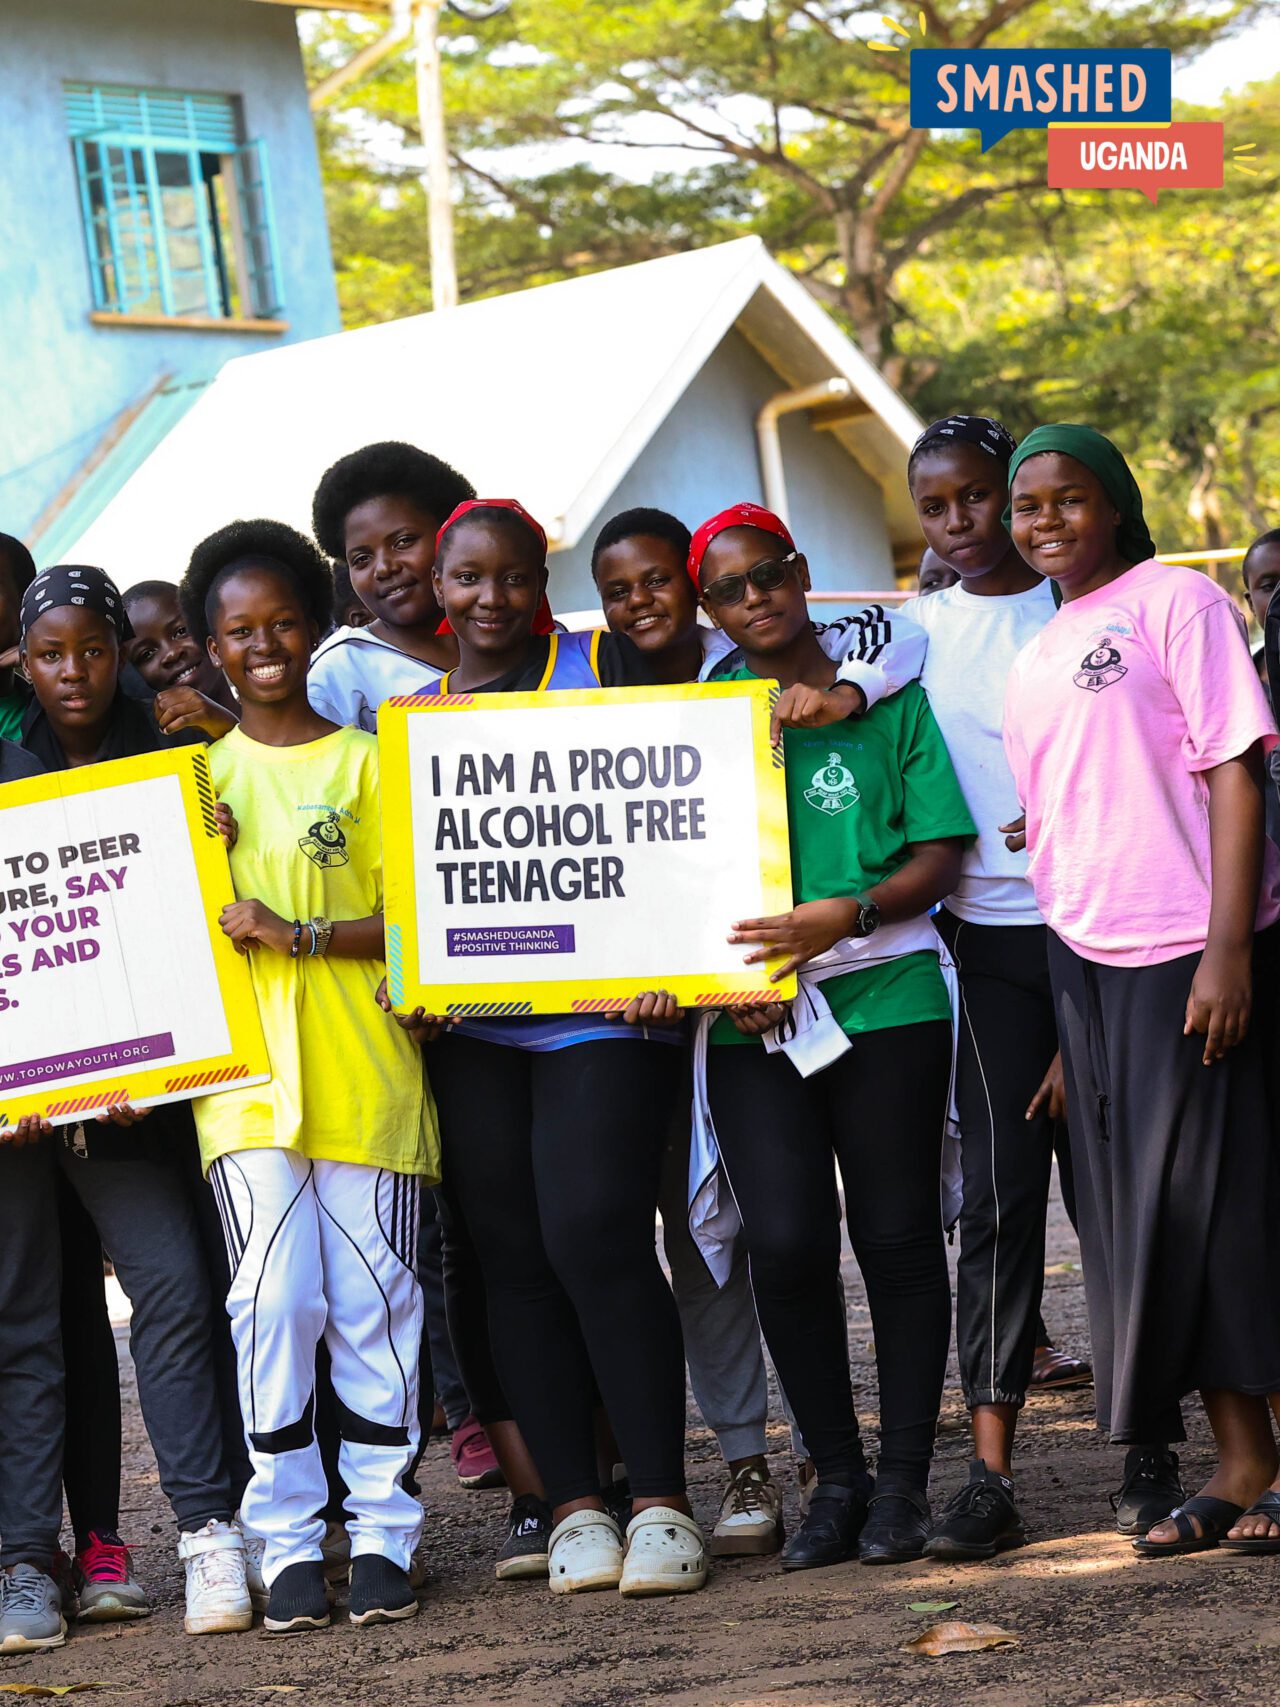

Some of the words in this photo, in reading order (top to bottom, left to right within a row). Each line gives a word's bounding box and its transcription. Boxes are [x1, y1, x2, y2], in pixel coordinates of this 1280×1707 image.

[431, 755, 441, 797] I
[455, 753, 515, 796] AM
[529, 751, 556, 794] A
[569, 744, 702, 792] PROUD
[434, 802, 612, 851] ALCOHOL
[625, 797, 707, 844] FREE
[4, 851, 50, 876] TO
[58, 832, 142, 870] PEER
[65, 865, 128, 900] SAY
[436, 856, 626, 905] TEENAGER
[8, 905, 101, 943] YOUR
[452, 929, 556, 942] #SMASHEDUGANDA
[31, 938, 101, 973] AND
[452, 942, 507, 953] #POSITIVE
[508, 940, 560, 951] THINKING
